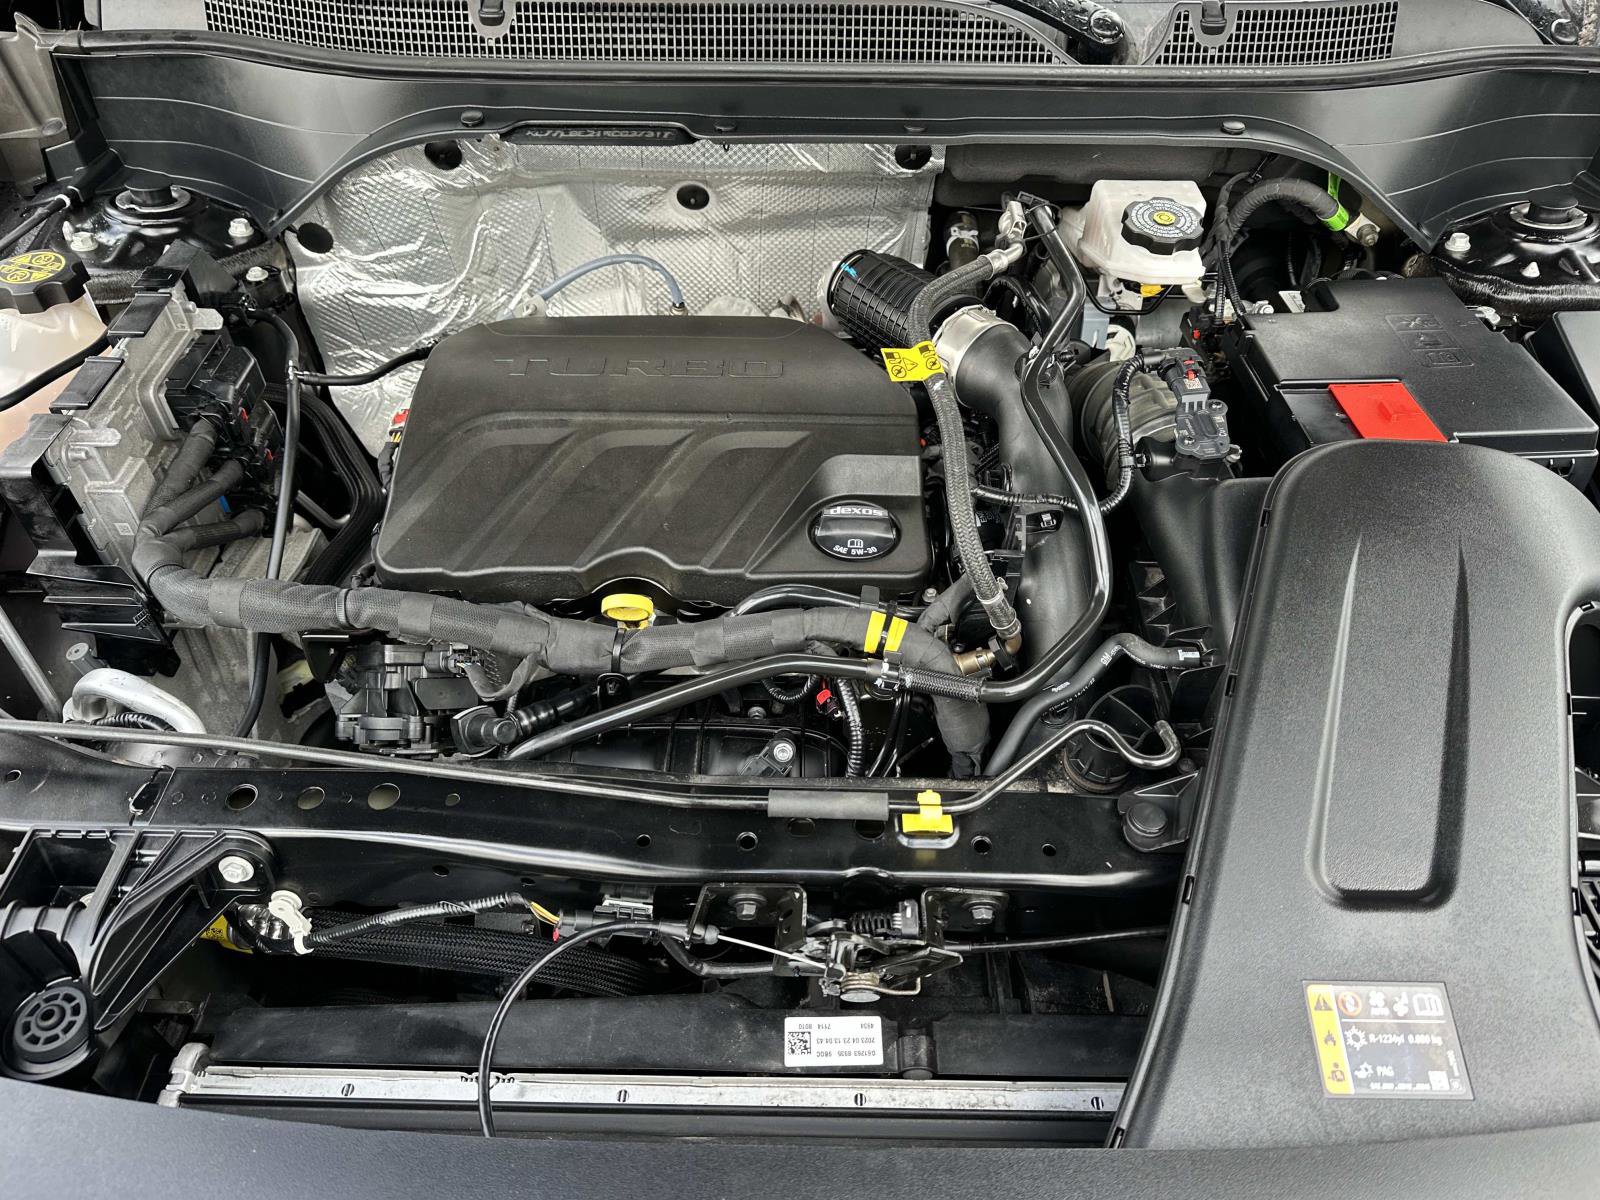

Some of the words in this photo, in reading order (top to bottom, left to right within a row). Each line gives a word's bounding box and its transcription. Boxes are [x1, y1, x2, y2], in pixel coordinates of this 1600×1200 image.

[494, 357, 784, 379] TURBO
[829, 506, 885, 517] dexos
[833, 545, 849, 554] SAE
[850, 546, 878, 556] 5W-30
